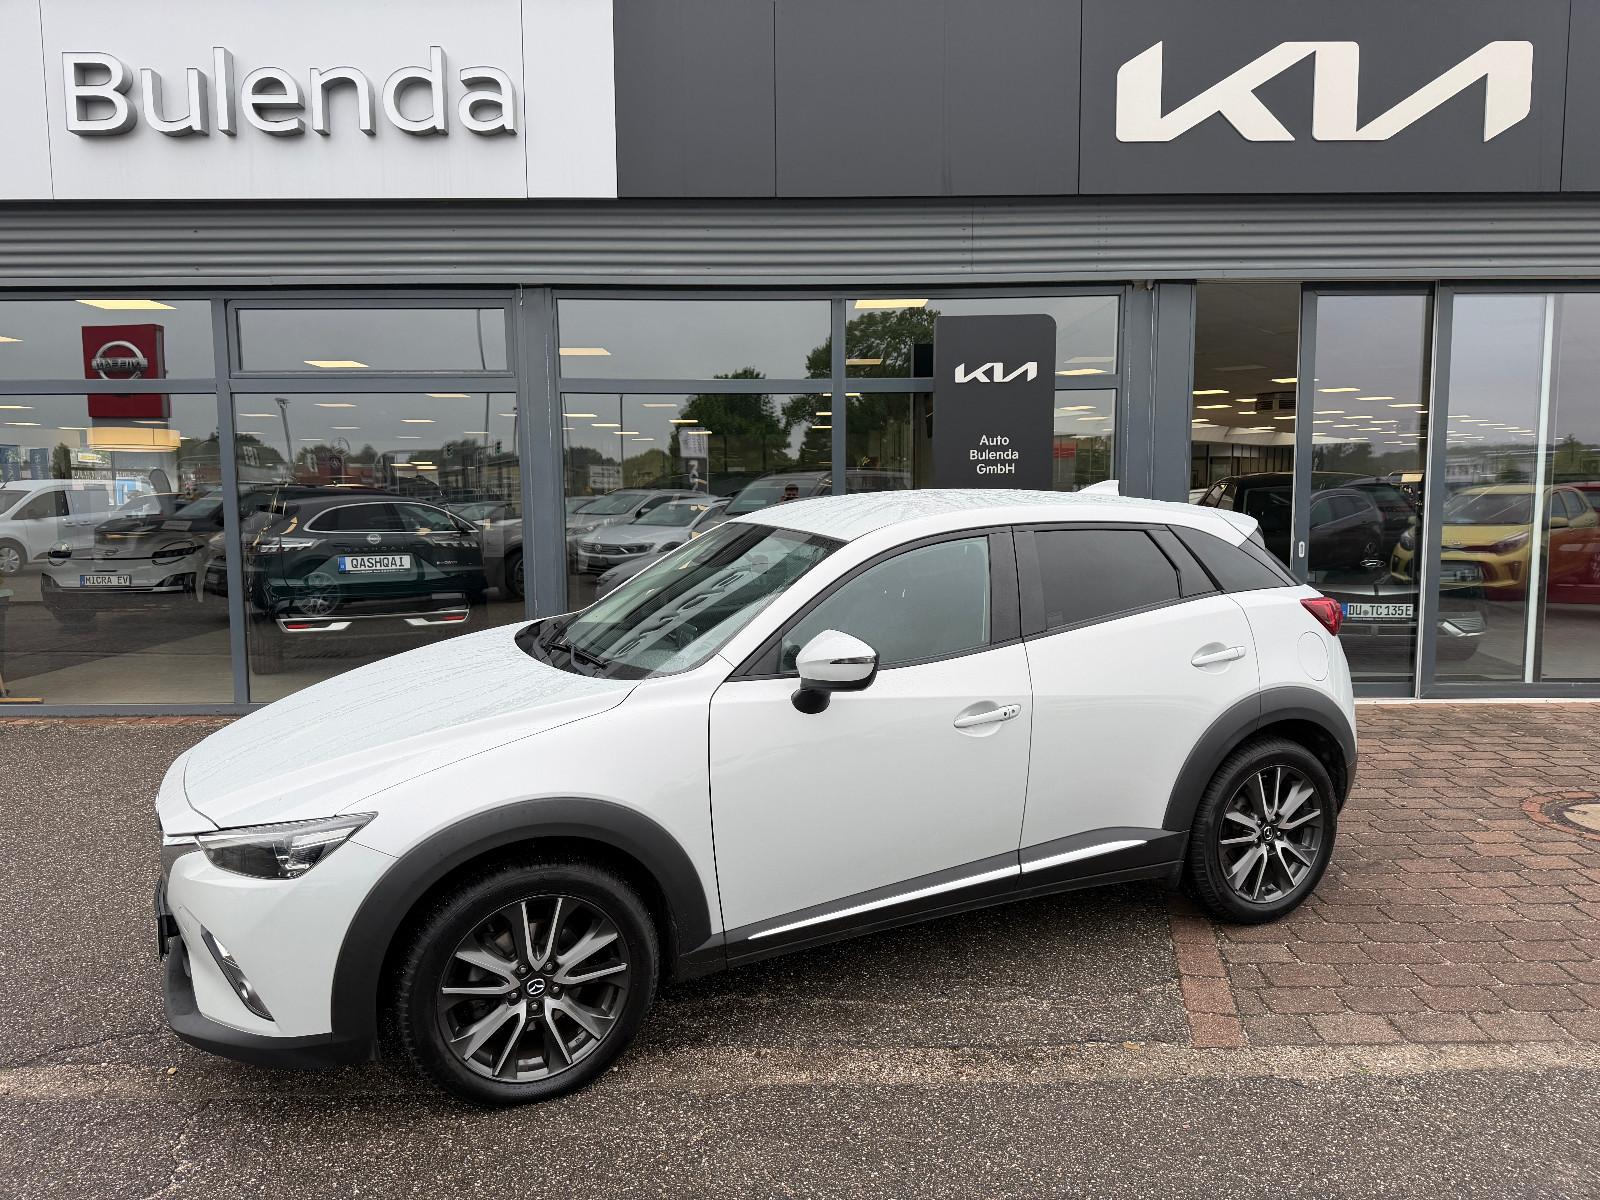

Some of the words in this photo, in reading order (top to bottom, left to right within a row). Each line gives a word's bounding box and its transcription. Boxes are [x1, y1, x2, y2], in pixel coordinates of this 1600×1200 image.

[61, 46, 518, 137] Bulenda
[1116, 40, 1534, 142] KIA
[955, 362, 1038, 383] KIA
[979, 434, 1010, 446] Auto
[969, 449, 1019, 461] Bulenda
[976, 463, 1015, 475] GmbH
[351, 557, 405, 569] QASHQAI
[85, 576, 113, 585] MICRA
[117, 576, 129, 585] EV
[1349, 605, 1362, 616] DU
